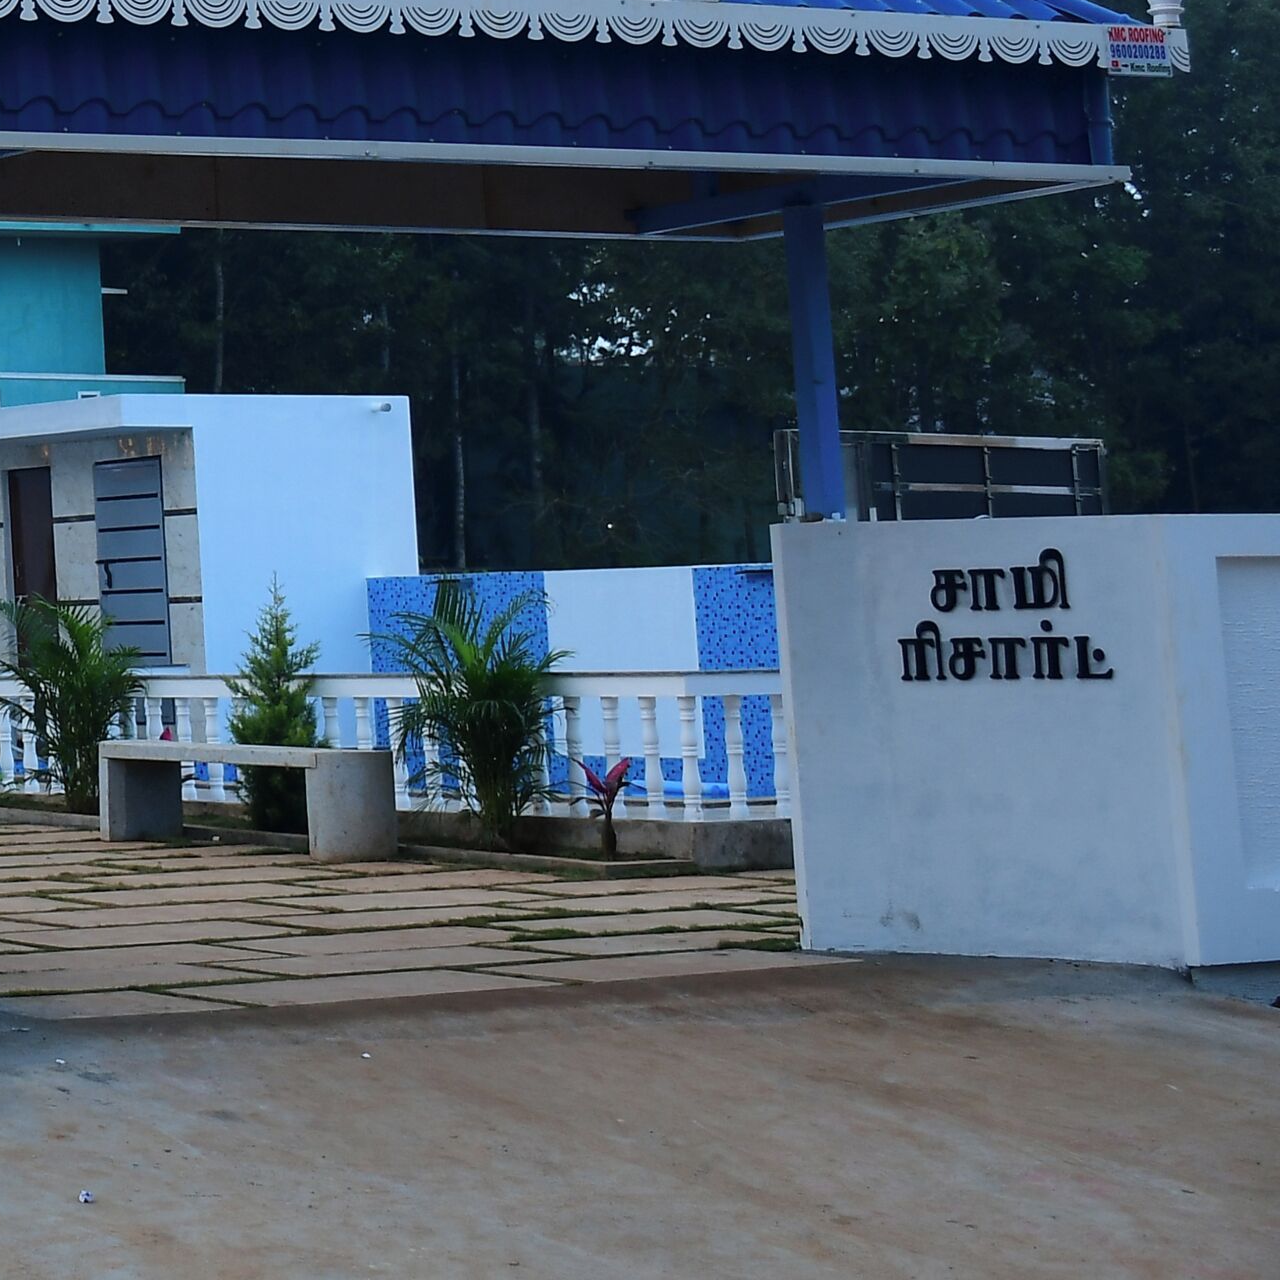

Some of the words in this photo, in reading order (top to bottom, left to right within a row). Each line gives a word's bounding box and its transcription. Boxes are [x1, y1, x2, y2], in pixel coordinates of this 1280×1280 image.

[1108, 26, 1127, 42] KMC
[1127, 27, 1165, 43] ROOFING
[930, 547, 1072, 612] சாமி
[897, 619, 1115, 681] ரிசார்ட்
